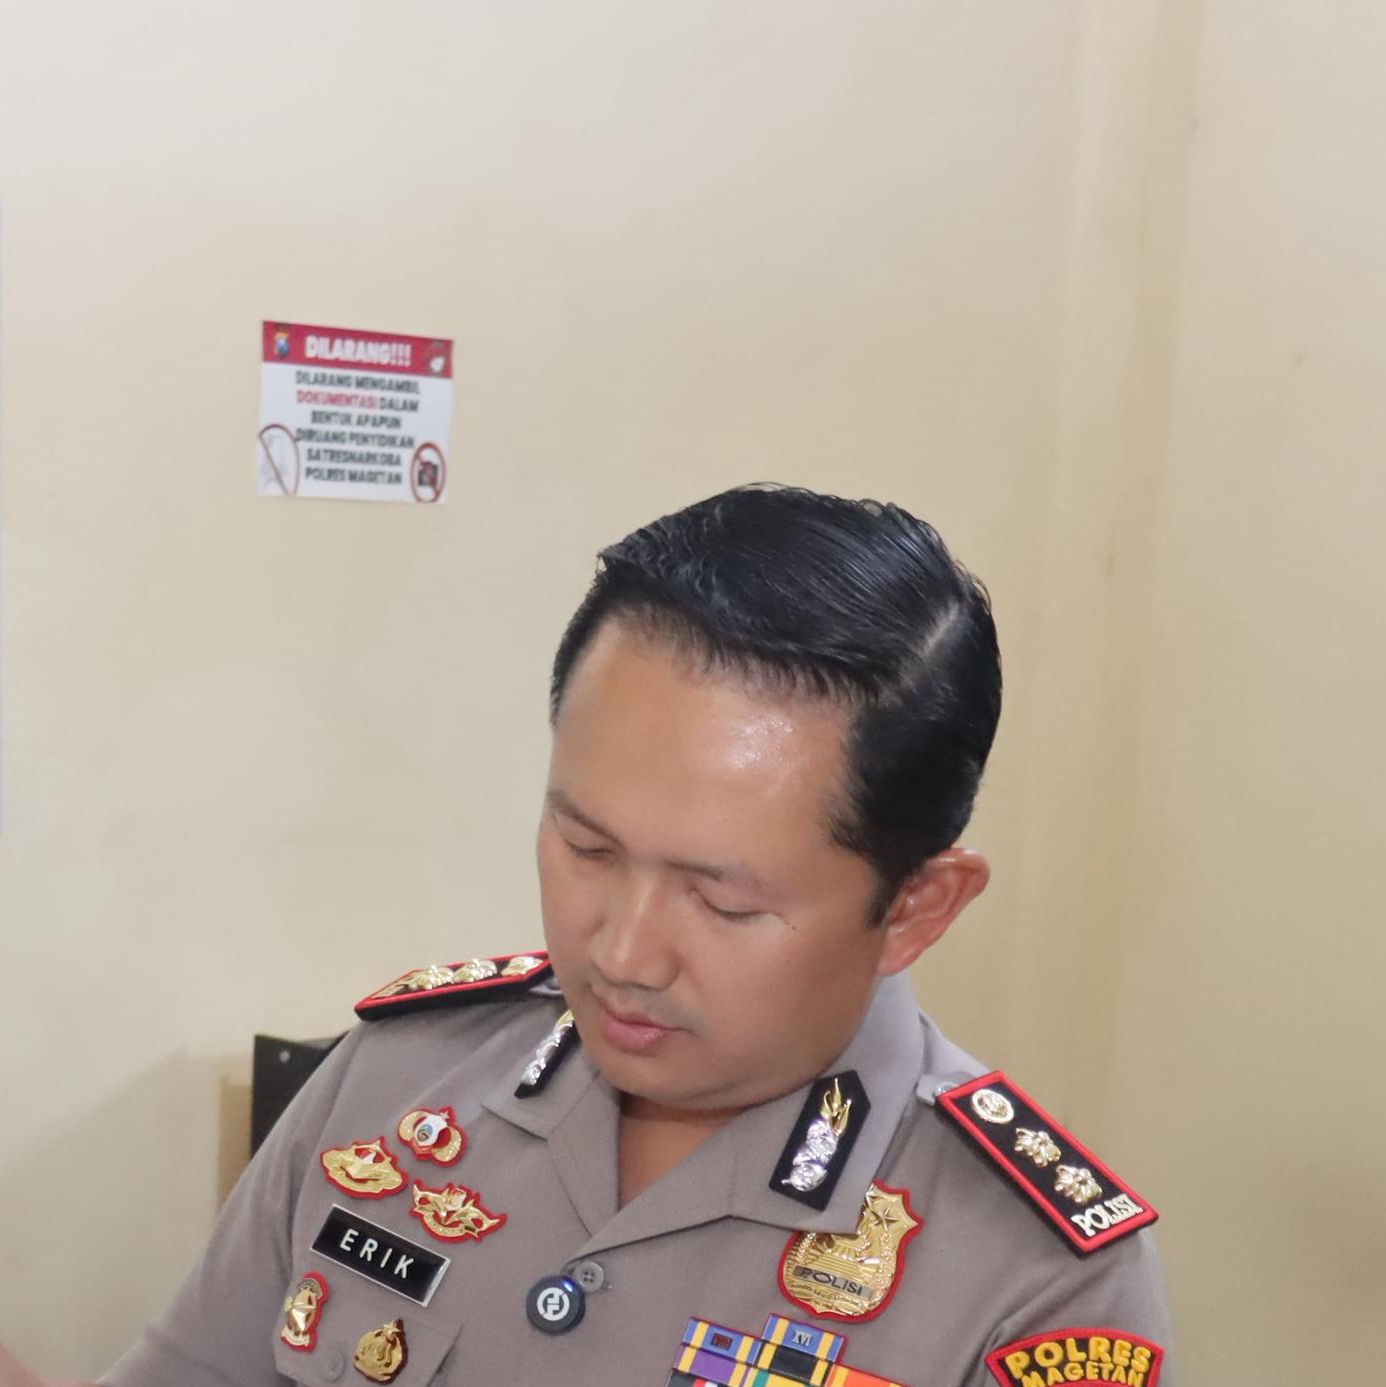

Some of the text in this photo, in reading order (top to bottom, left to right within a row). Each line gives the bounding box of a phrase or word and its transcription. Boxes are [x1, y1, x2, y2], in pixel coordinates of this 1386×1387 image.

[295, 370, 421, 394] DILARANG MENGAMBIL
[296, 390, 419, 413] DOKUMENTASI DALAM
[311, 410, 402, 429] BENTUK APAPUN
[349, 432, 416, 449] PENYIDIKAN
[306, 448, 403, 467] SATRESNARKOBA
[305, 466, 403, 485] POLRES MAGETAN
[1071, 1193, 1144, 1236] POLISI
[340, 1228, 414, 1279] ERIK
[799, 1266, 863, 1296] POLISI
[1004, 1336, 1151, 1379] POLRES
